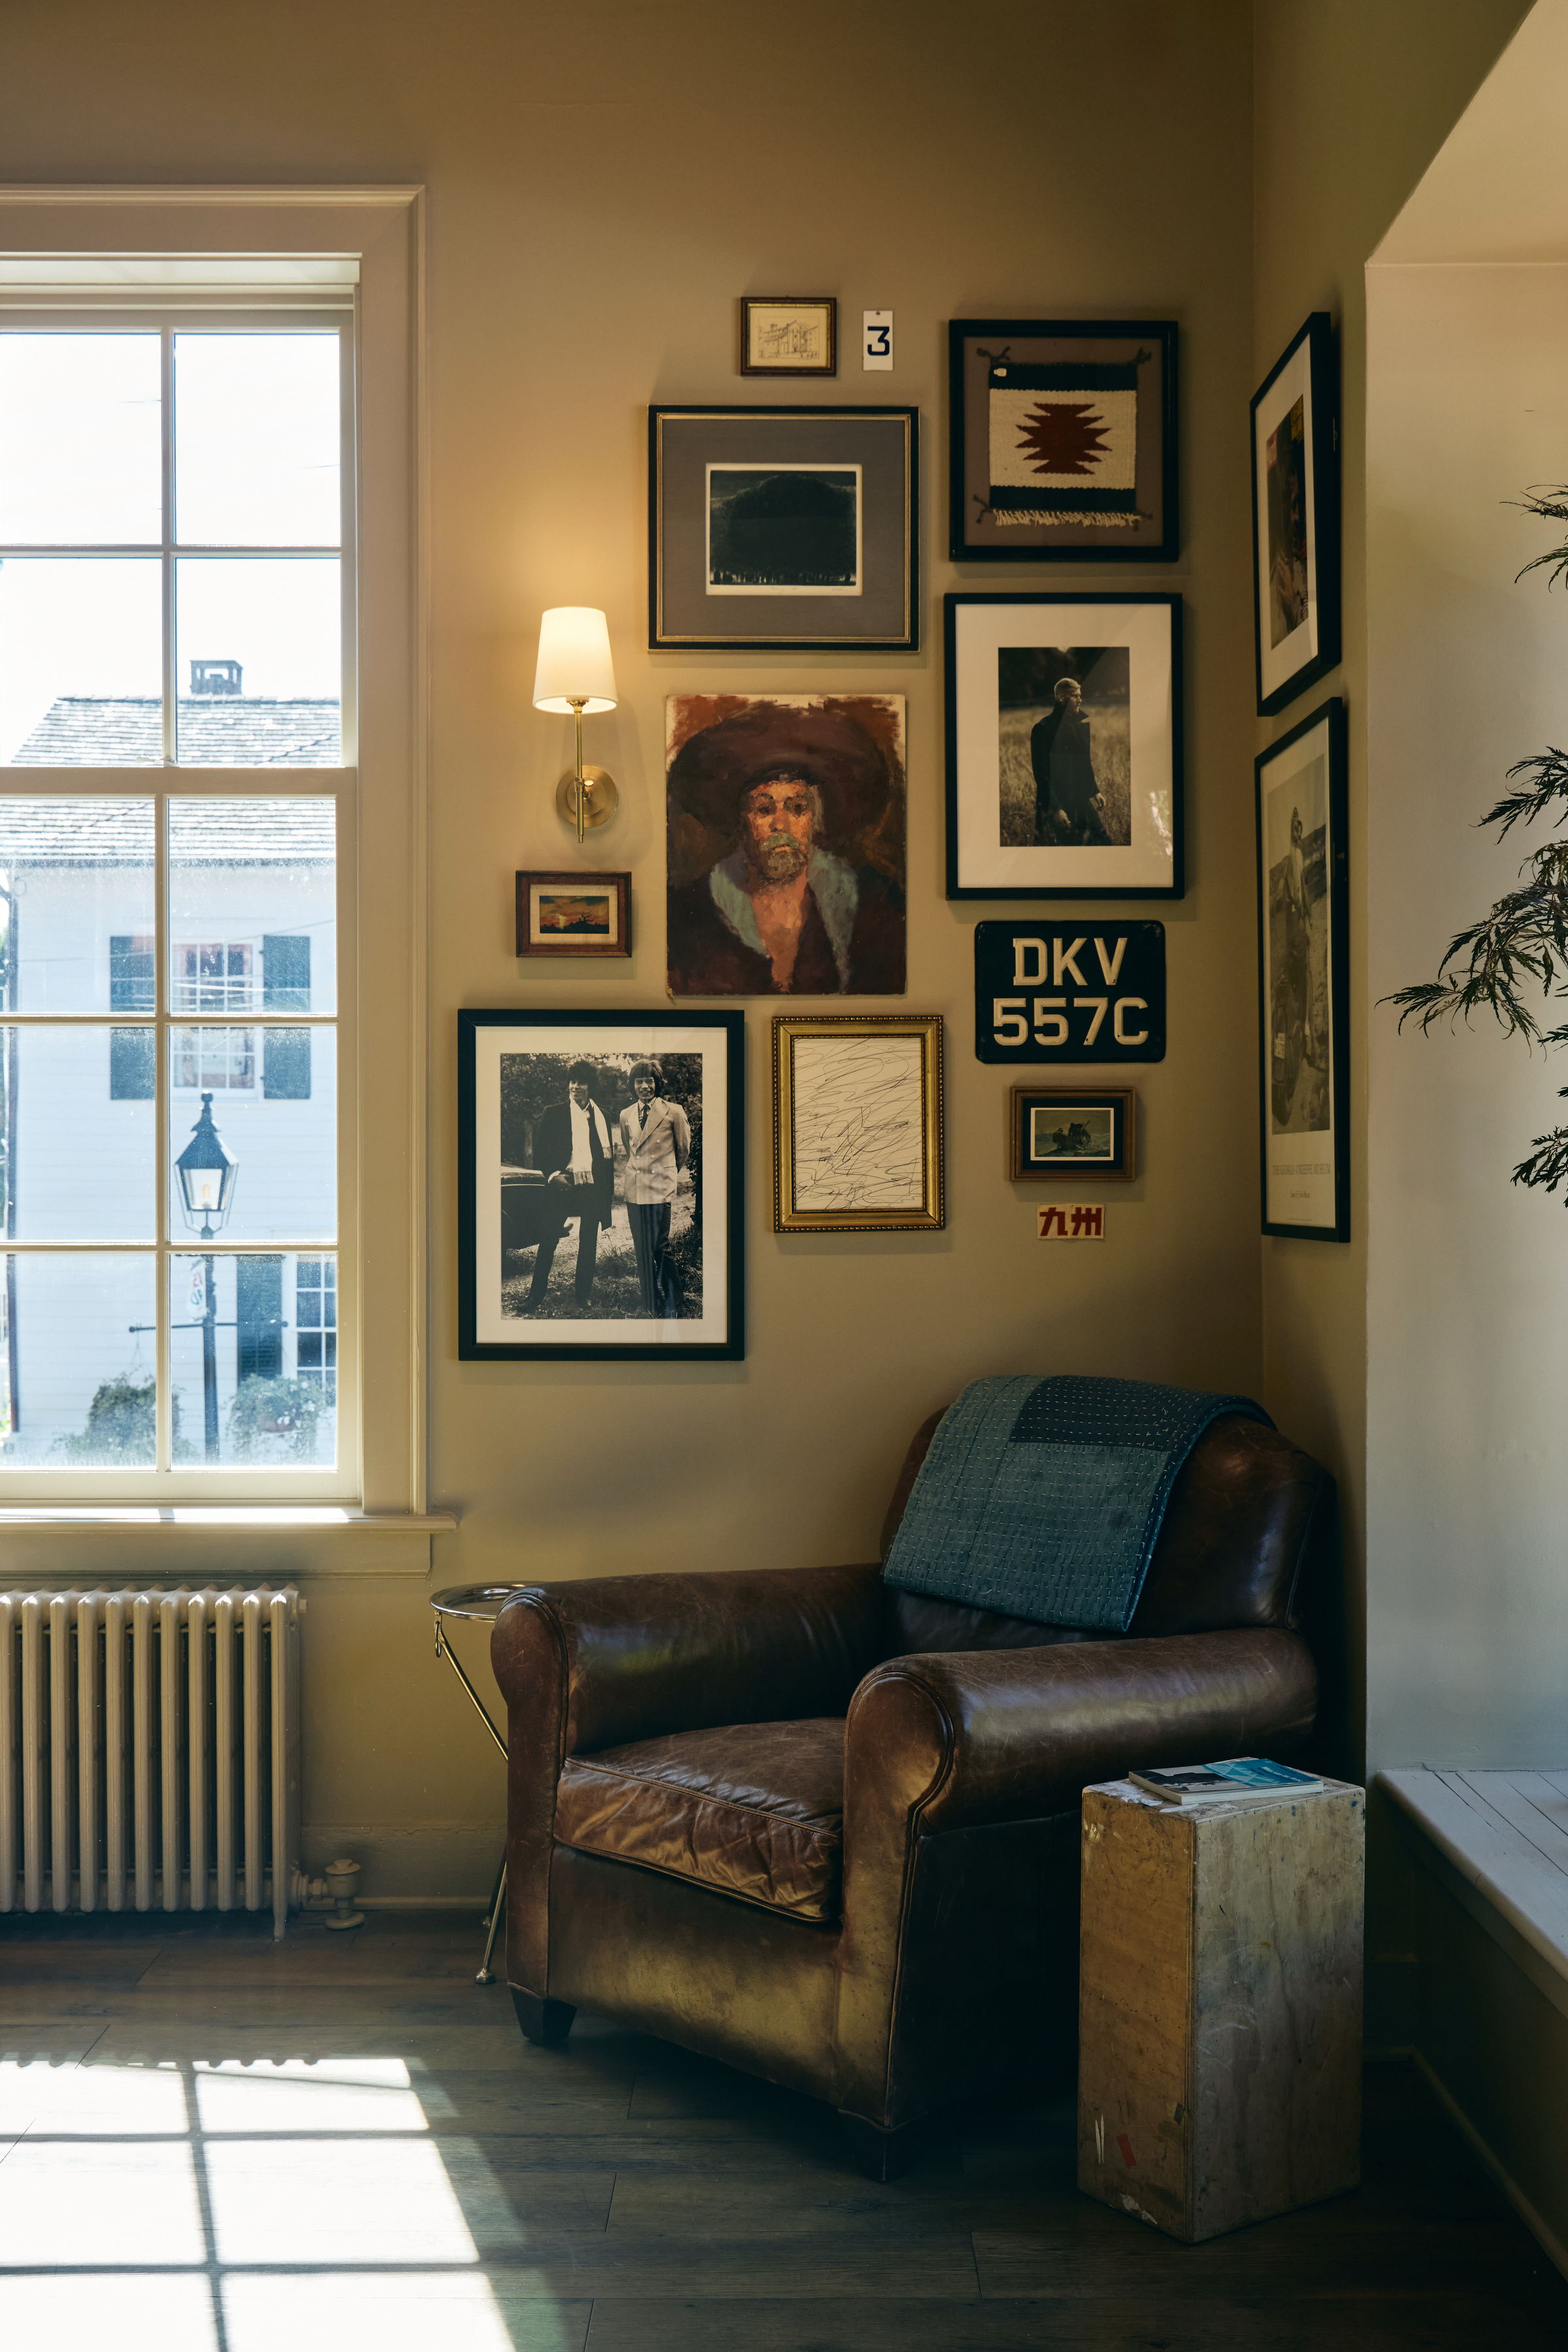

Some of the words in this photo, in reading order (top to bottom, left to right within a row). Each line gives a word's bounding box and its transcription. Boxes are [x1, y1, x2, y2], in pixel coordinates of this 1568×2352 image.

[867, 326, 890, 356] 3
[1013, 938, 1128, 986] DKV
[993, 997, 1149, 1046] 557C
[1039, 1207, 1102, 1236] 九州
